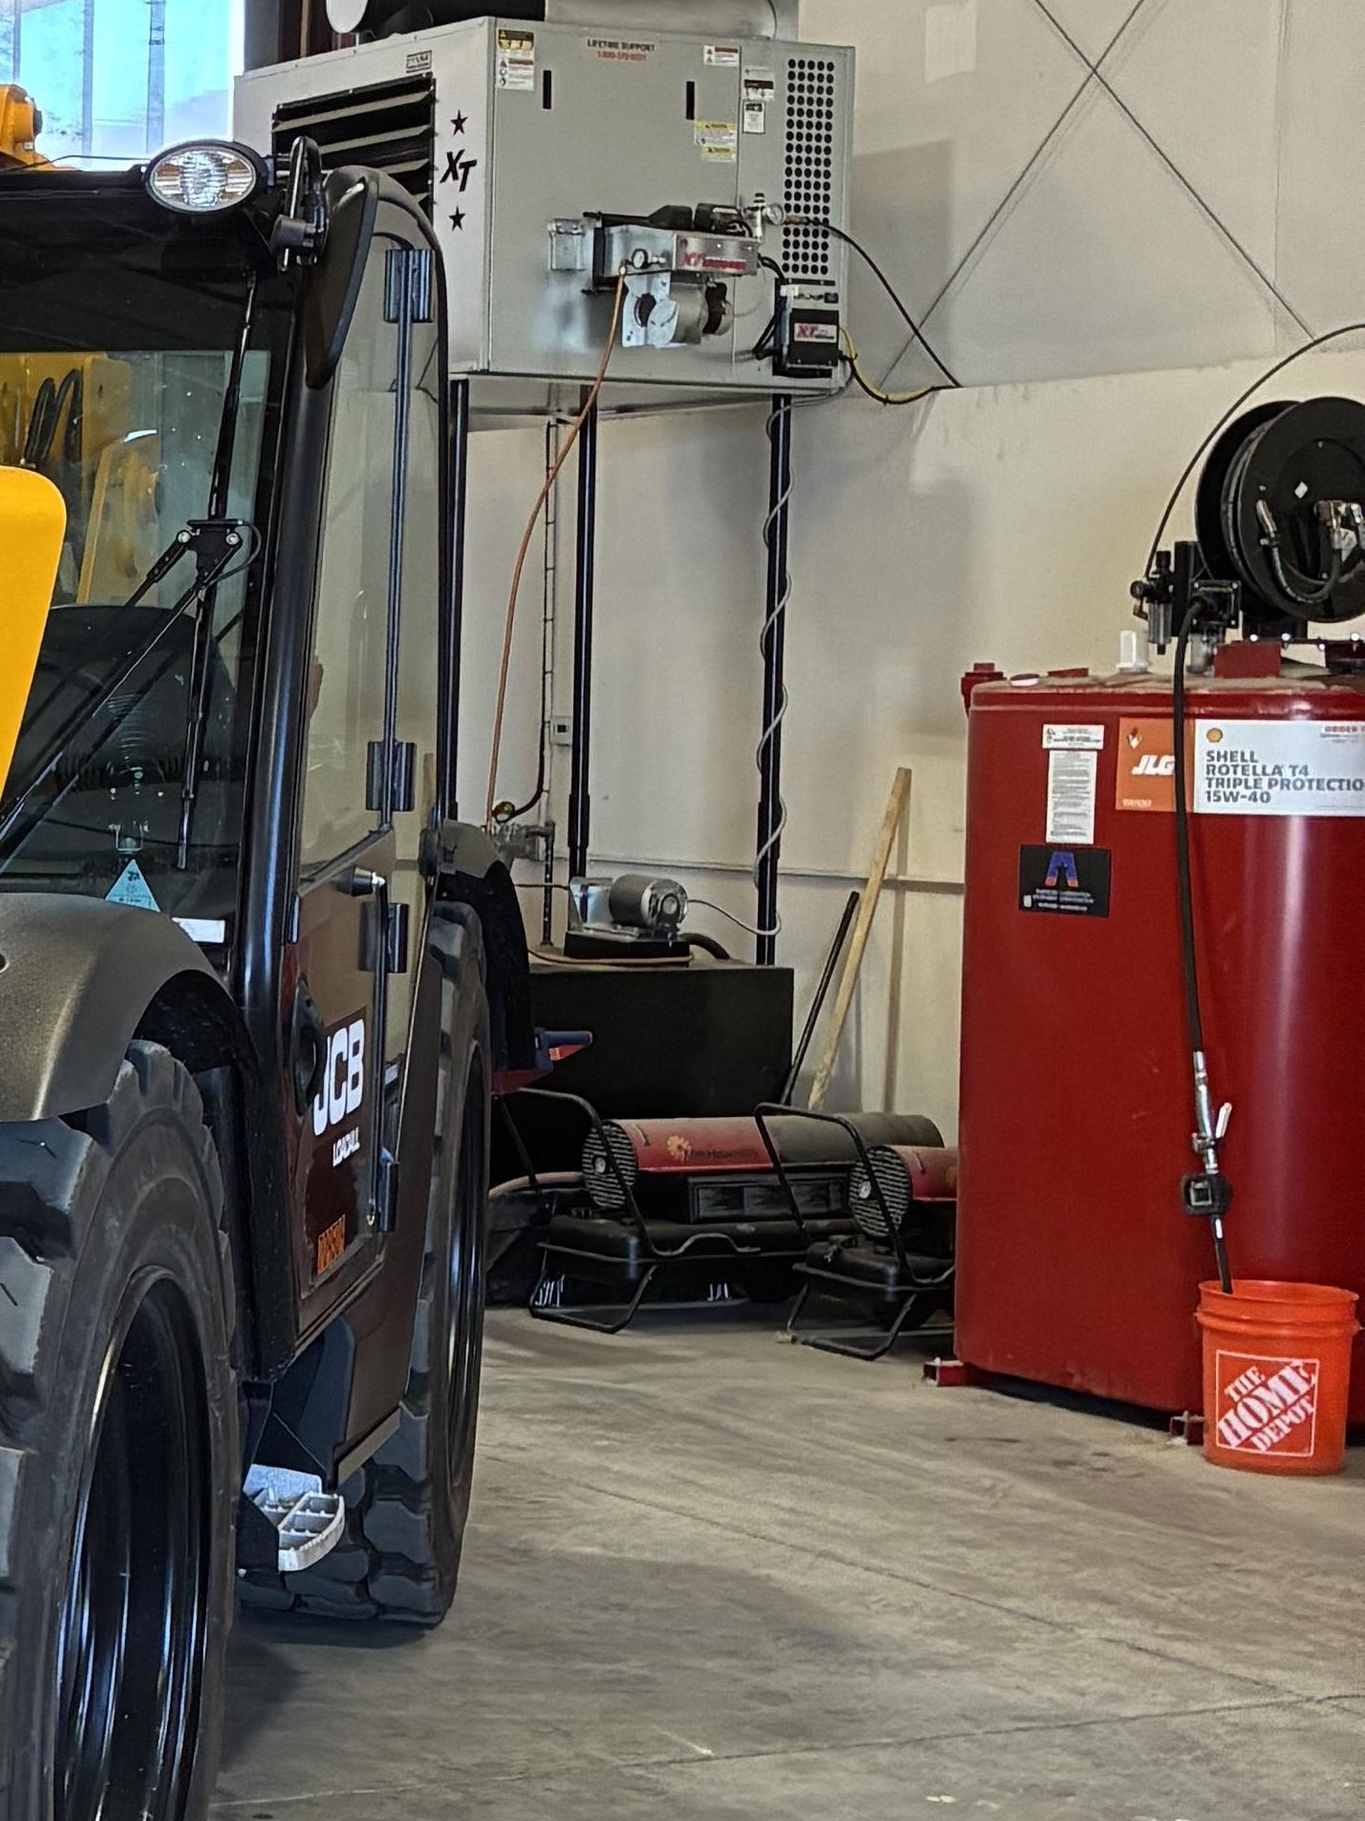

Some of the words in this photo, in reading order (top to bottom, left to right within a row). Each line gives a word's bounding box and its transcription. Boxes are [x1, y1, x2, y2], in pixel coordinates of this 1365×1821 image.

[439, 149, 478, 192] XT
[1131, 754, 1175, 775] JLG
[1206, 750, 1259, 763] SHELL
[1206, 763, 1283, 777] ROTELLA
[1288, 764, 1310, 777] T4
[1205, 777, 1263, 790] TRIPLE
[1267, 778, 1365, 791] PROTECTIO
[1205, 790, 1272, 804] 15W-40
[313, 1018, 365, 1136] JCB
[1224, 1366, 1266, 1403] THE
[1218, 1359, 1317, 1449] HOME
[1250, 1396, 1315, 1451] DEPOT
